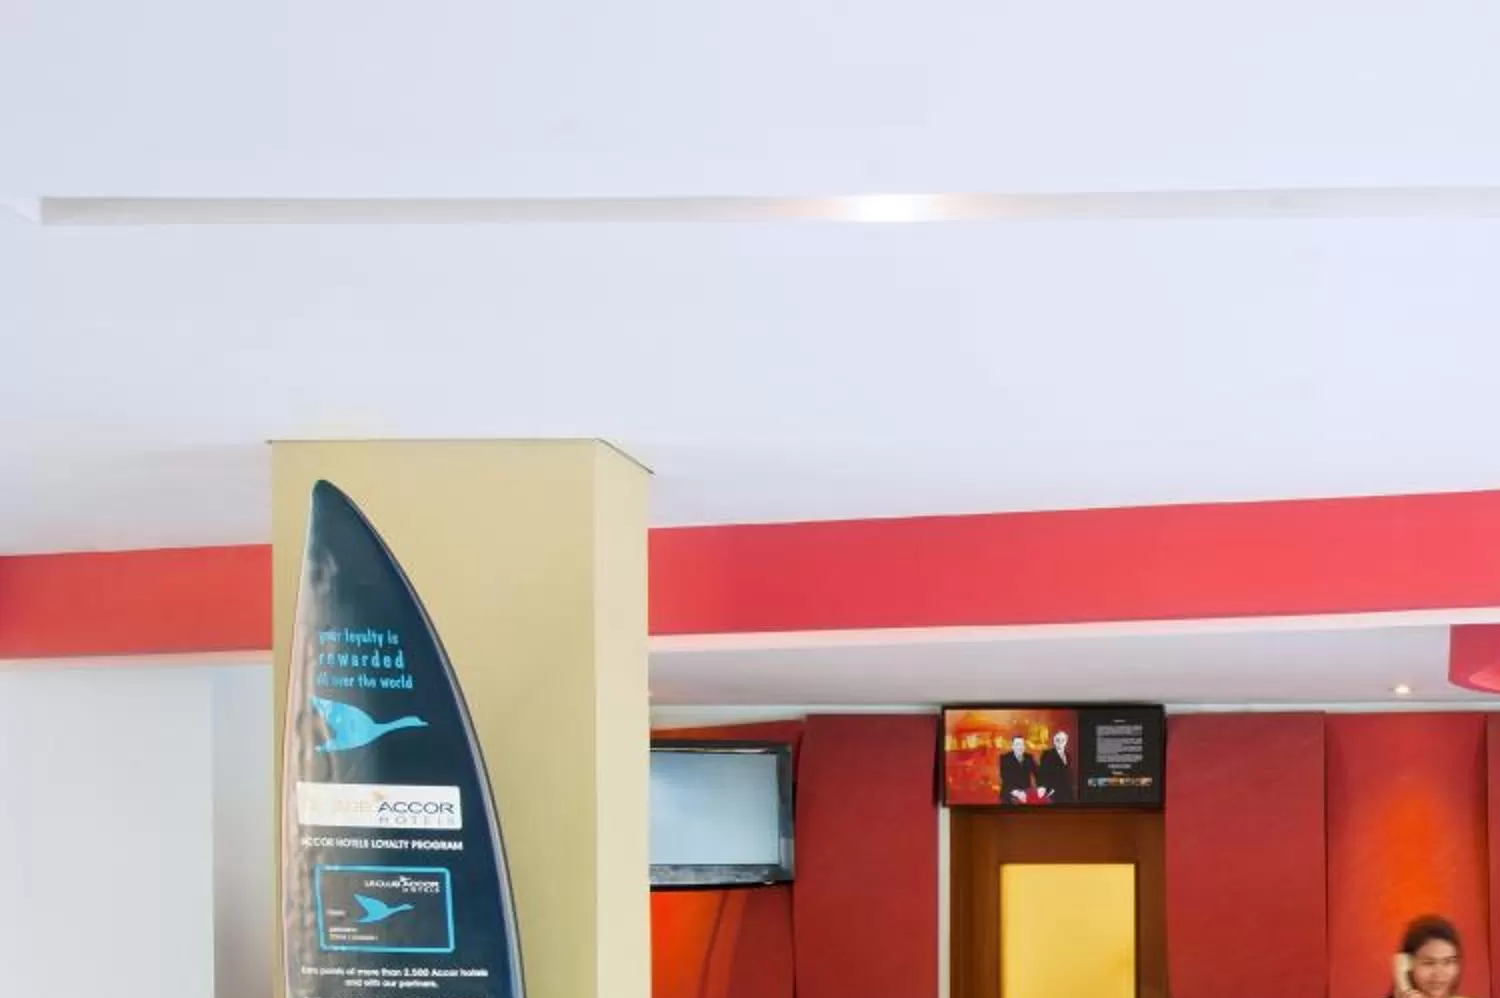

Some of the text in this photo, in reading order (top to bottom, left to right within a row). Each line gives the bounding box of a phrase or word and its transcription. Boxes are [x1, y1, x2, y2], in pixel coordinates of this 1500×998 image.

[388, 629, 399, 645] is
[319, 649, 404, 669] rewarded
[357, 674, 377, 689] the
[380, 674, 413, 689] world
[377, 801, 454, 814] ACCOR
[301, 836, 464, 850] ACCOR HOTELS LOYALTY PROGRAM
